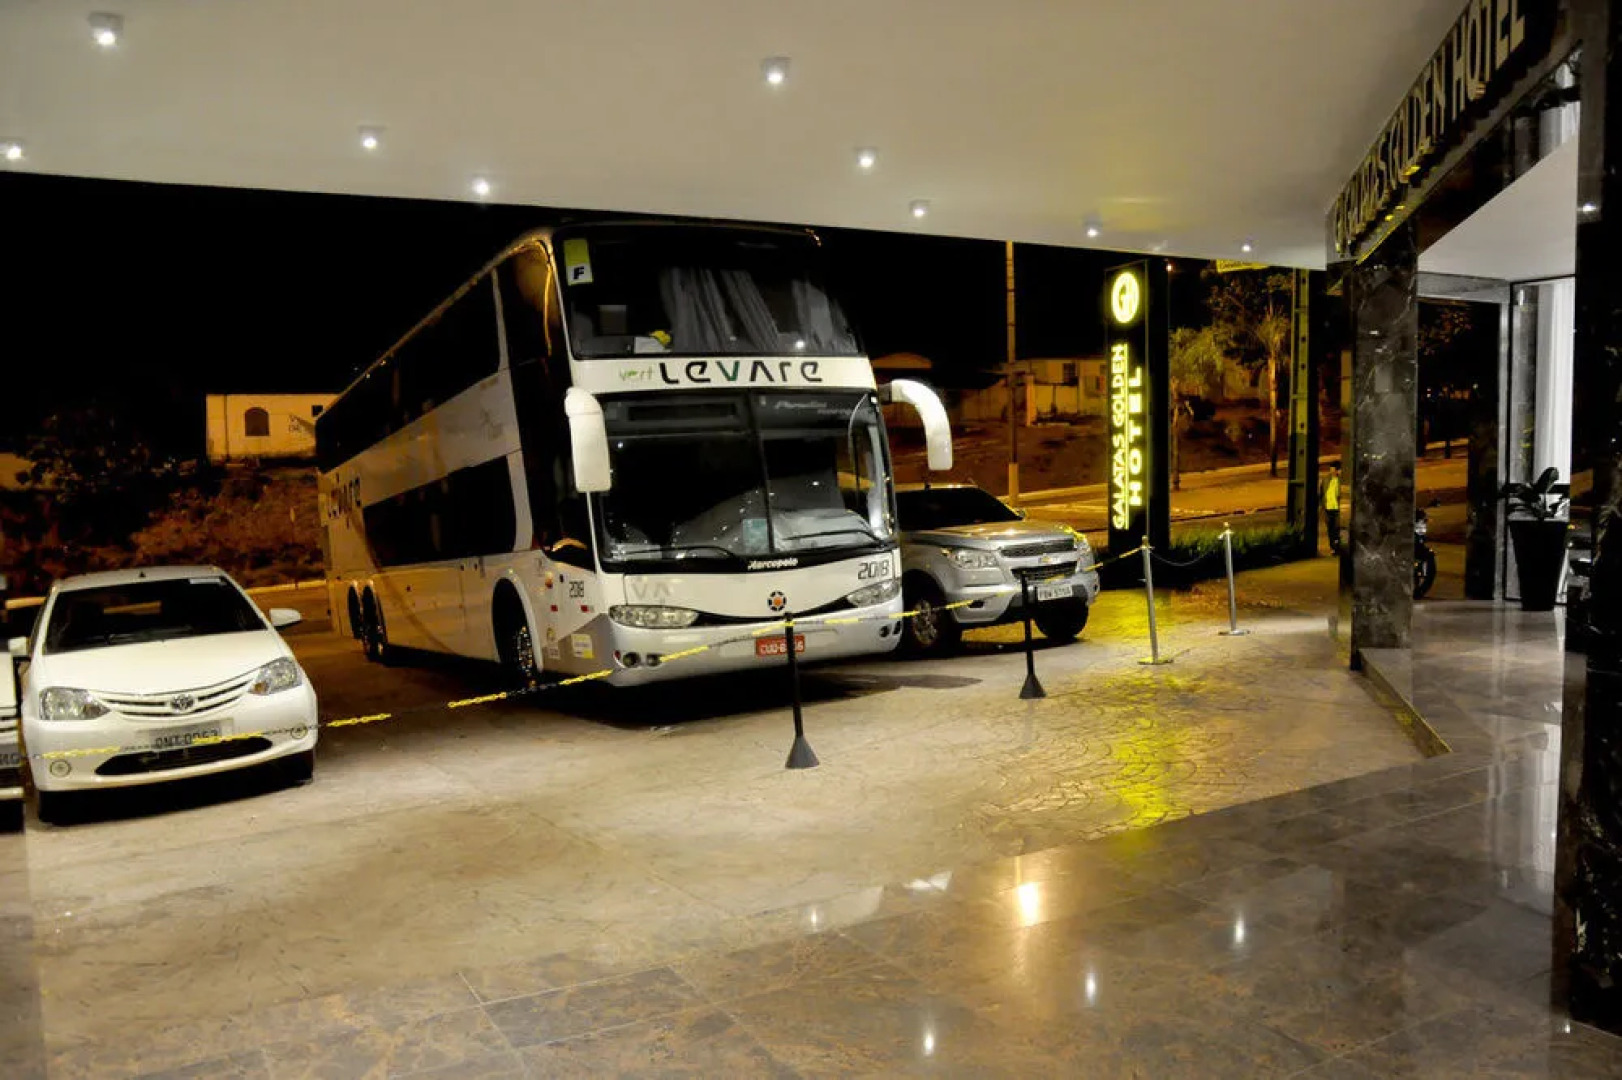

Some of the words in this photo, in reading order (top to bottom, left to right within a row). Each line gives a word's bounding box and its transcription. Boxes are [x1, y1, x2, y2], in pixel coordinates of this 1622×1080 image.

[1451, 0, 1525, 121] HOTEL
[573, 265, 585, 280] F
[1112, 345, 1126, 429] GOLDEN
[1112, 434, 1126, 530] GALATAS
[1128, 367, 1143, 506] HOTEL
